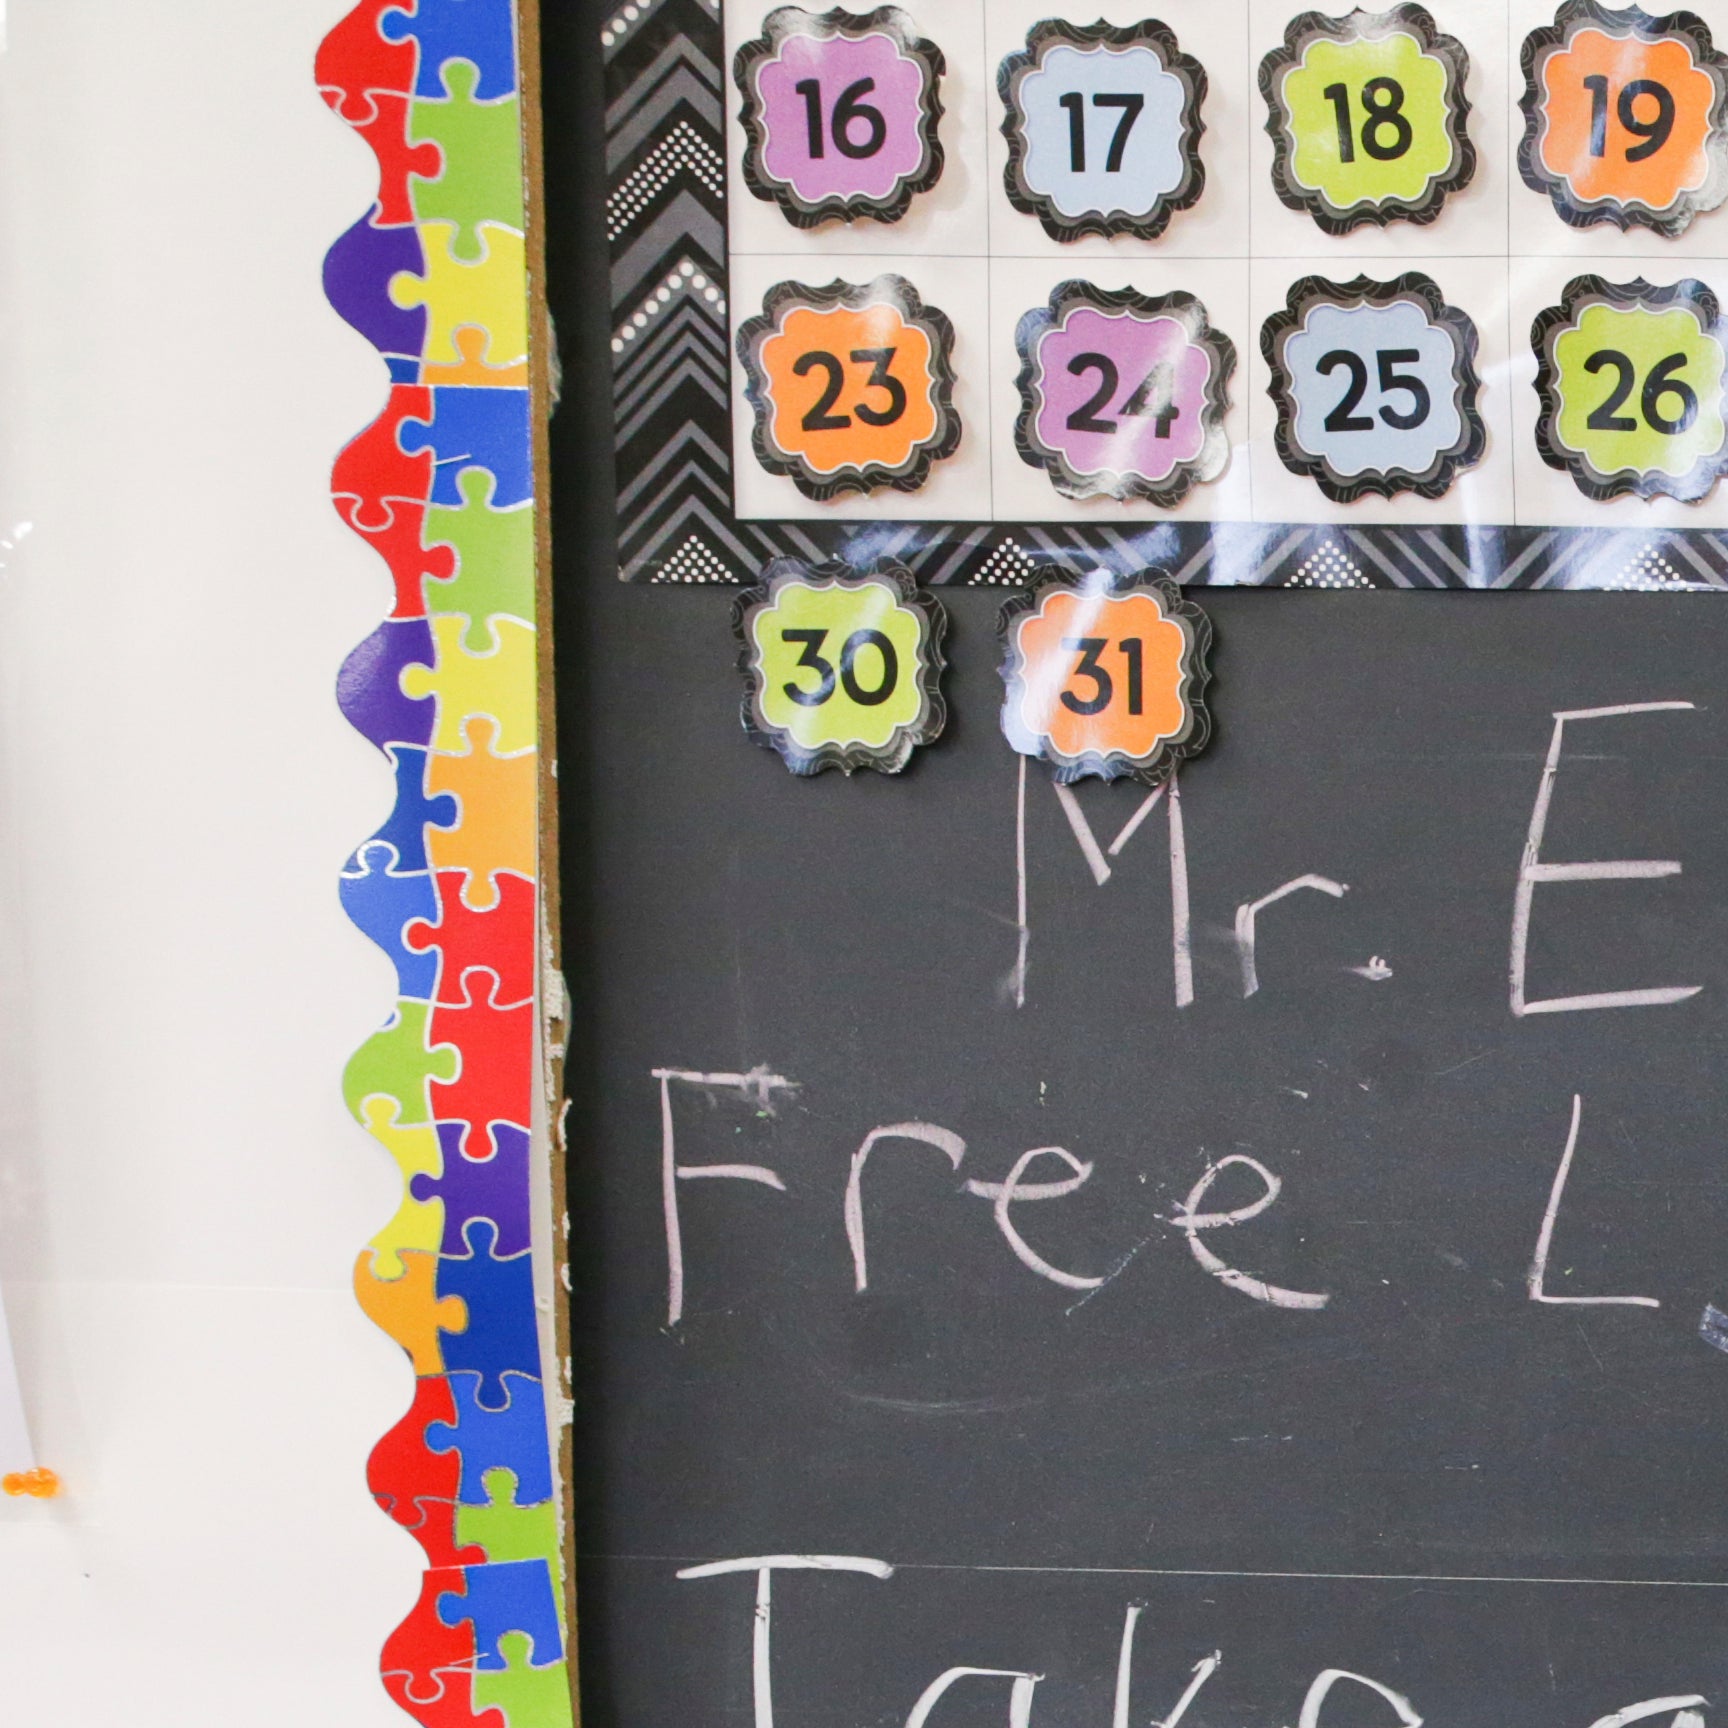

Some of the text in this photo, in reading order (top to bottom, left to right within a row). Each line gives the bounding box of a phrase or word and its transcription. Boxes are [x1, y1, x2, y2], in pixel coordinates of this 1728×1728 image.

[796, 77, 885, 161] 16
[1060, 93, 1145, 174] 17
[1323, 77, 1412, 163] 18
[1584, 75, 1676, 163] 19
[792, 346, 906, 432] 23
[1066, 352, 1178, 440] 24
[1315, 350, 1429, 431] 25
[1585, 350, 1697, 434] 26
[781, 628, 898, 708] 30
[1060, 637, 1143, 715] 31
[1015, 755, 1392, 1008] Mr.
[652, 1065, 1330, 1329] Free
